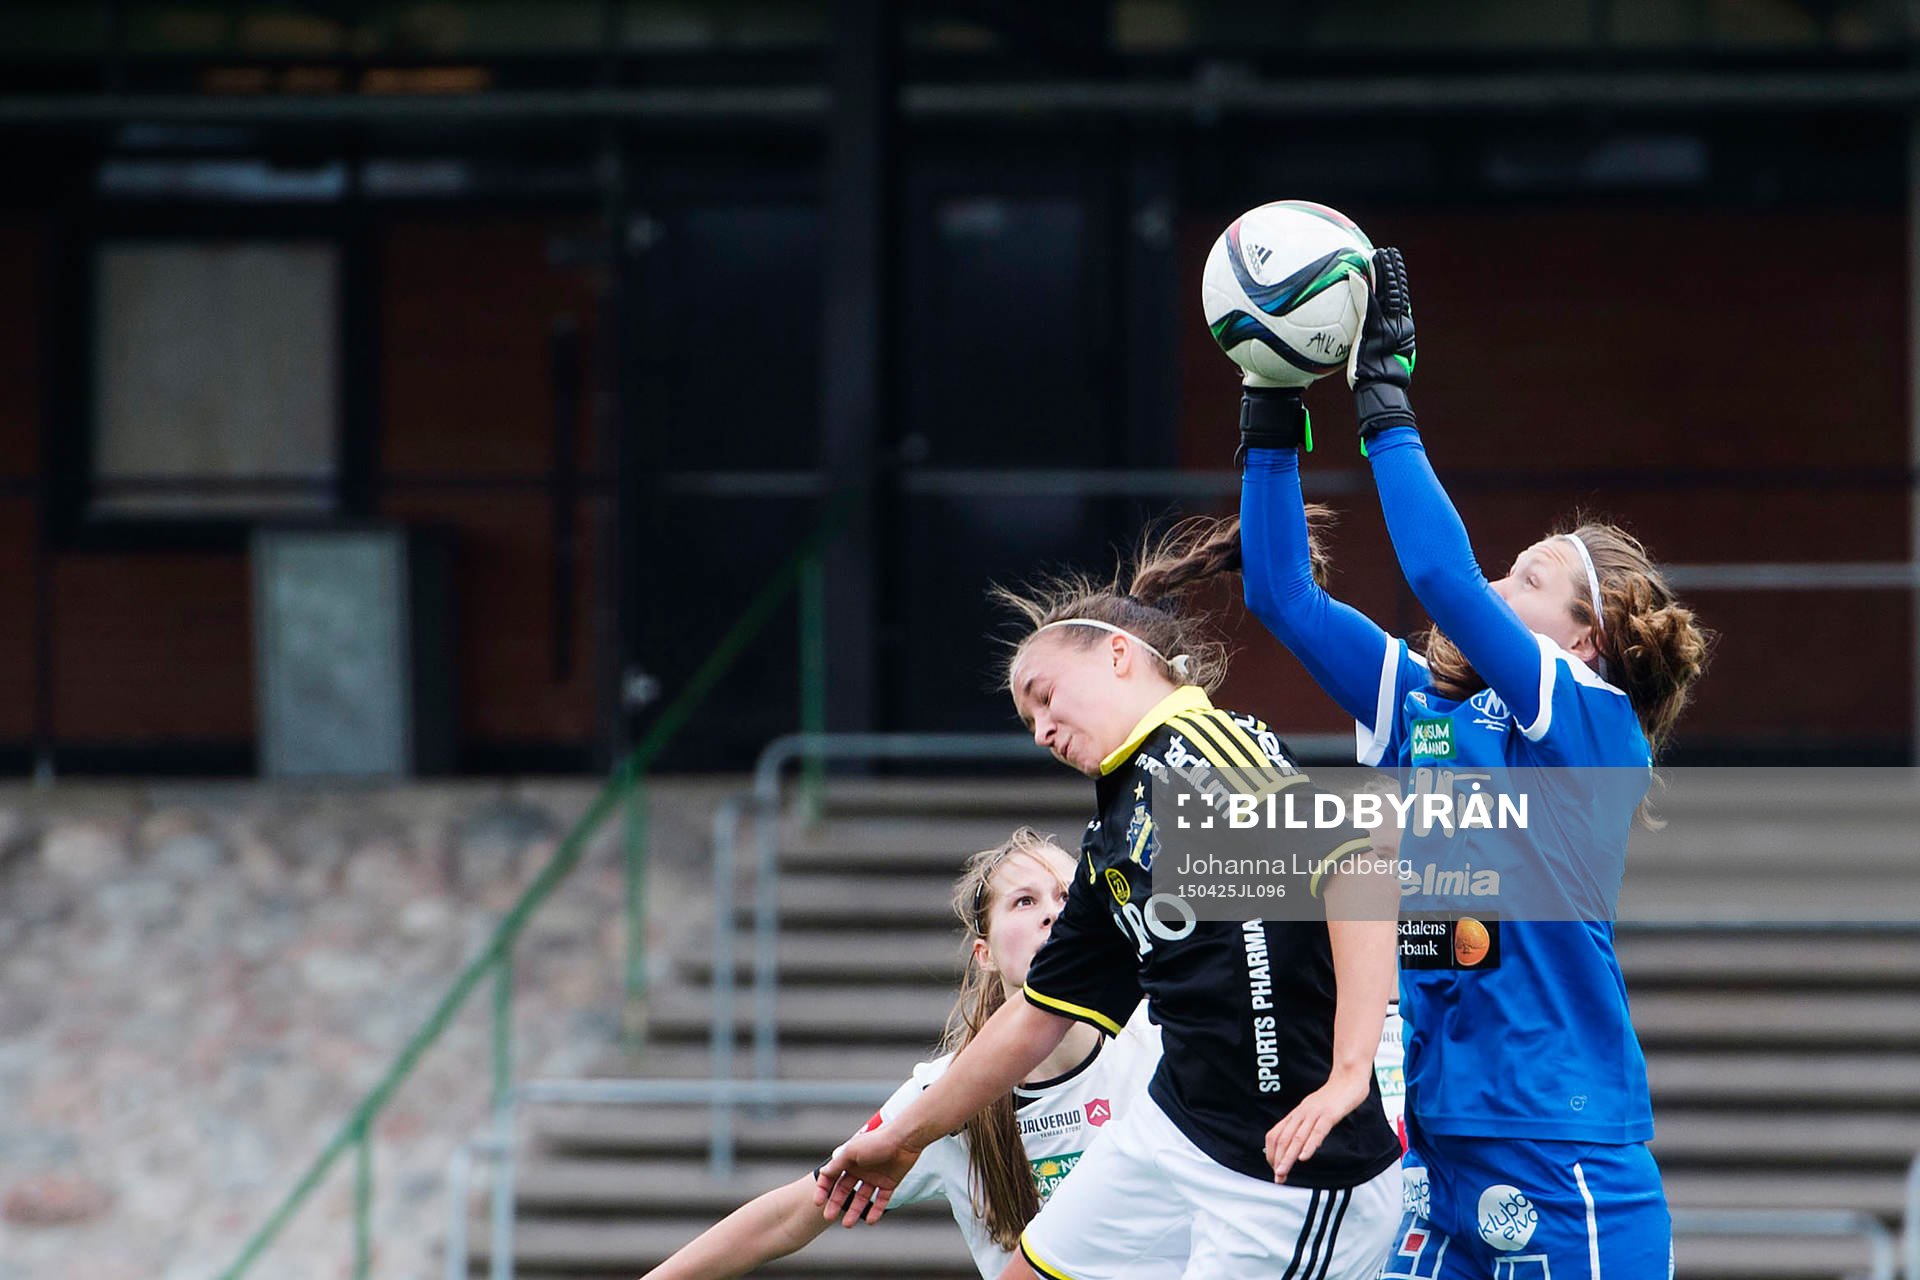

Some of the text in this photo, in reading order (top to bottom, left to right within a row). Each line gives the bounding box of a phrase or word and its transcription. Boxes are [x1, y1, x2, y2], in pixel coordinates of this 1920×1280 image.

[1400, 862, 1501, 897] elmia
[1397, 919, 1446, 936] sdalens
[1399, 940, 1439, 956] rbank
[1241, 917, 1281, 1093] SPORTS PHARMA
[1479, 1193, 1528, 1239] klubb
